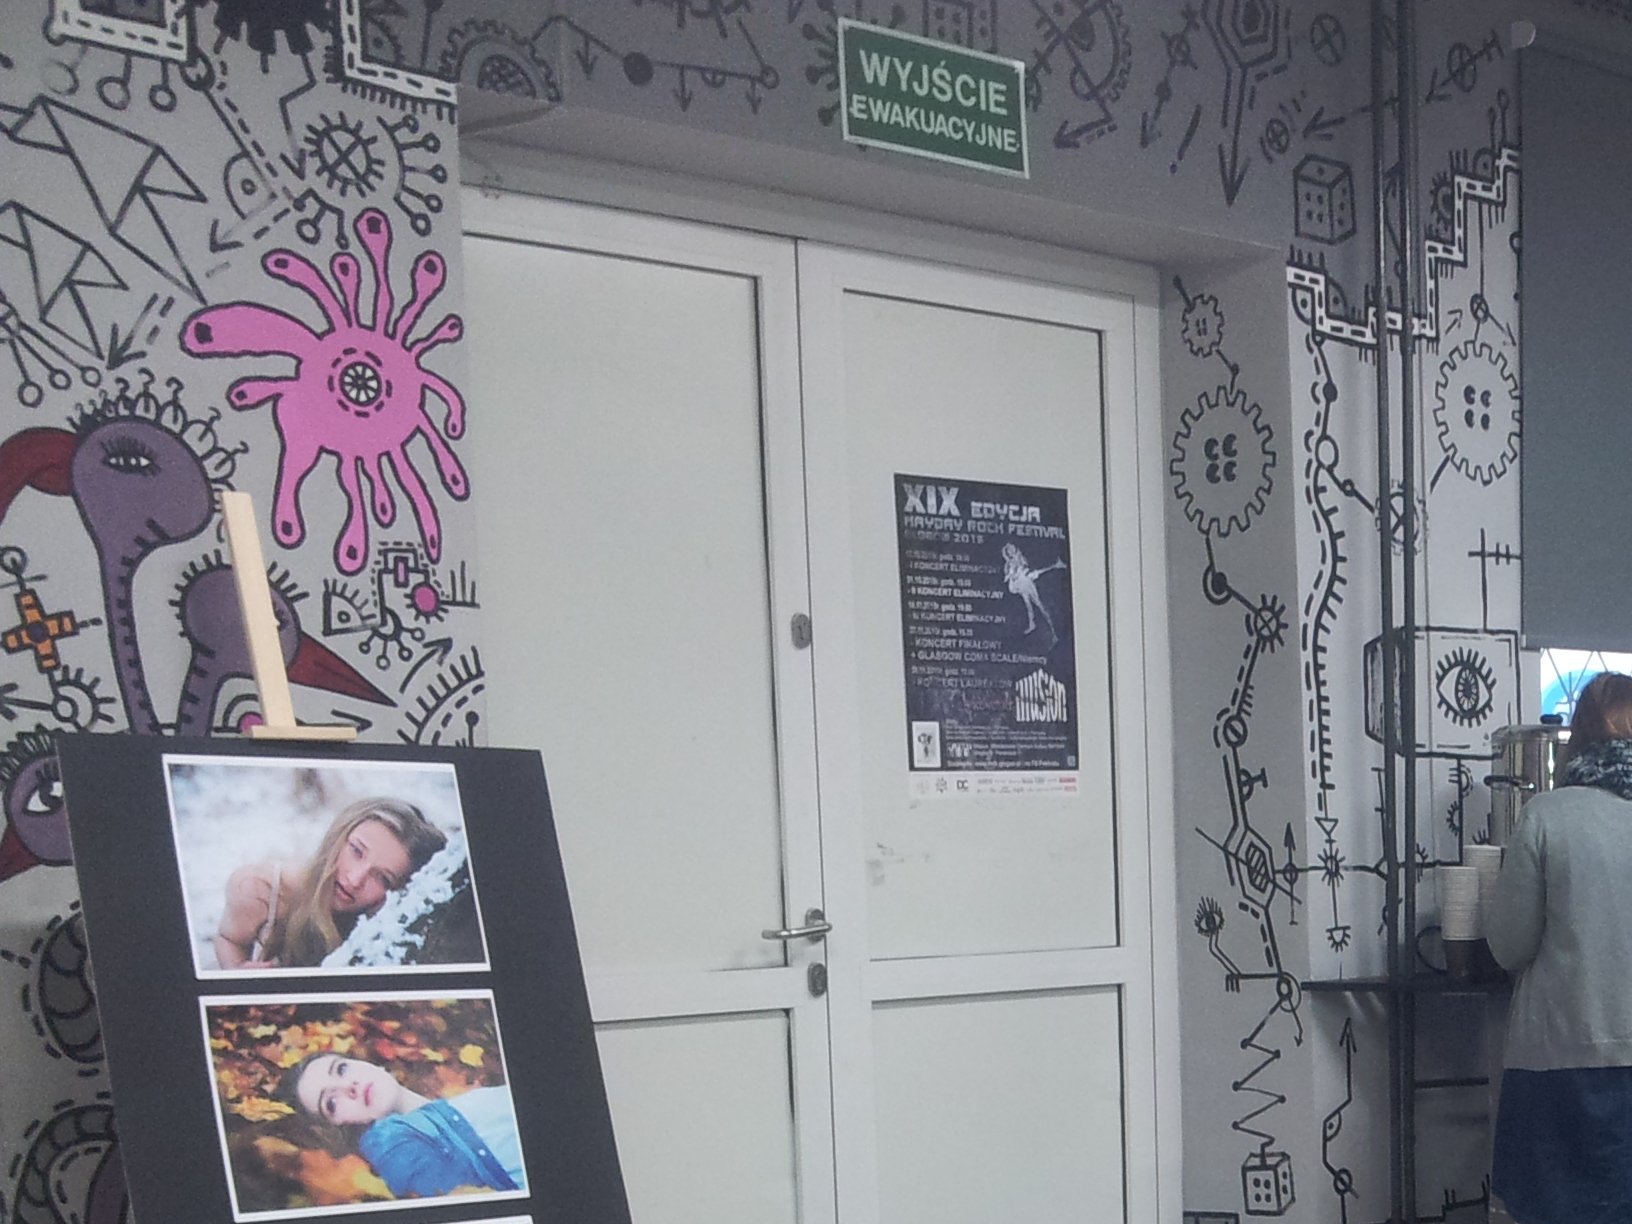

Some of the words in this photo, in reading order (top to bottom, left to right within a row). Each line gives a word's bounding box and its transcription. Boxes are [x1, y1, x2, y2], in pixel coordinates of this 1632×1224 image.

[859, 49, 1008, 116] WYJŚCIE
[851, 94, 1017, 153] EWAKUACYJNE
[903, 483, 961, 517] XIX
[971, 500, 1041, 523] EDYCJA
[904, 515, 963, 532] MAYDAY
[967, 519, 1004, 534] ROCK
[1008, 523, 1066, 540] FESTIVAL
[917, 586, 952, 596] KONCERT
[915, 637, 957, 648] KONCERT
[917, 650, 962, 661] GLASGOW
